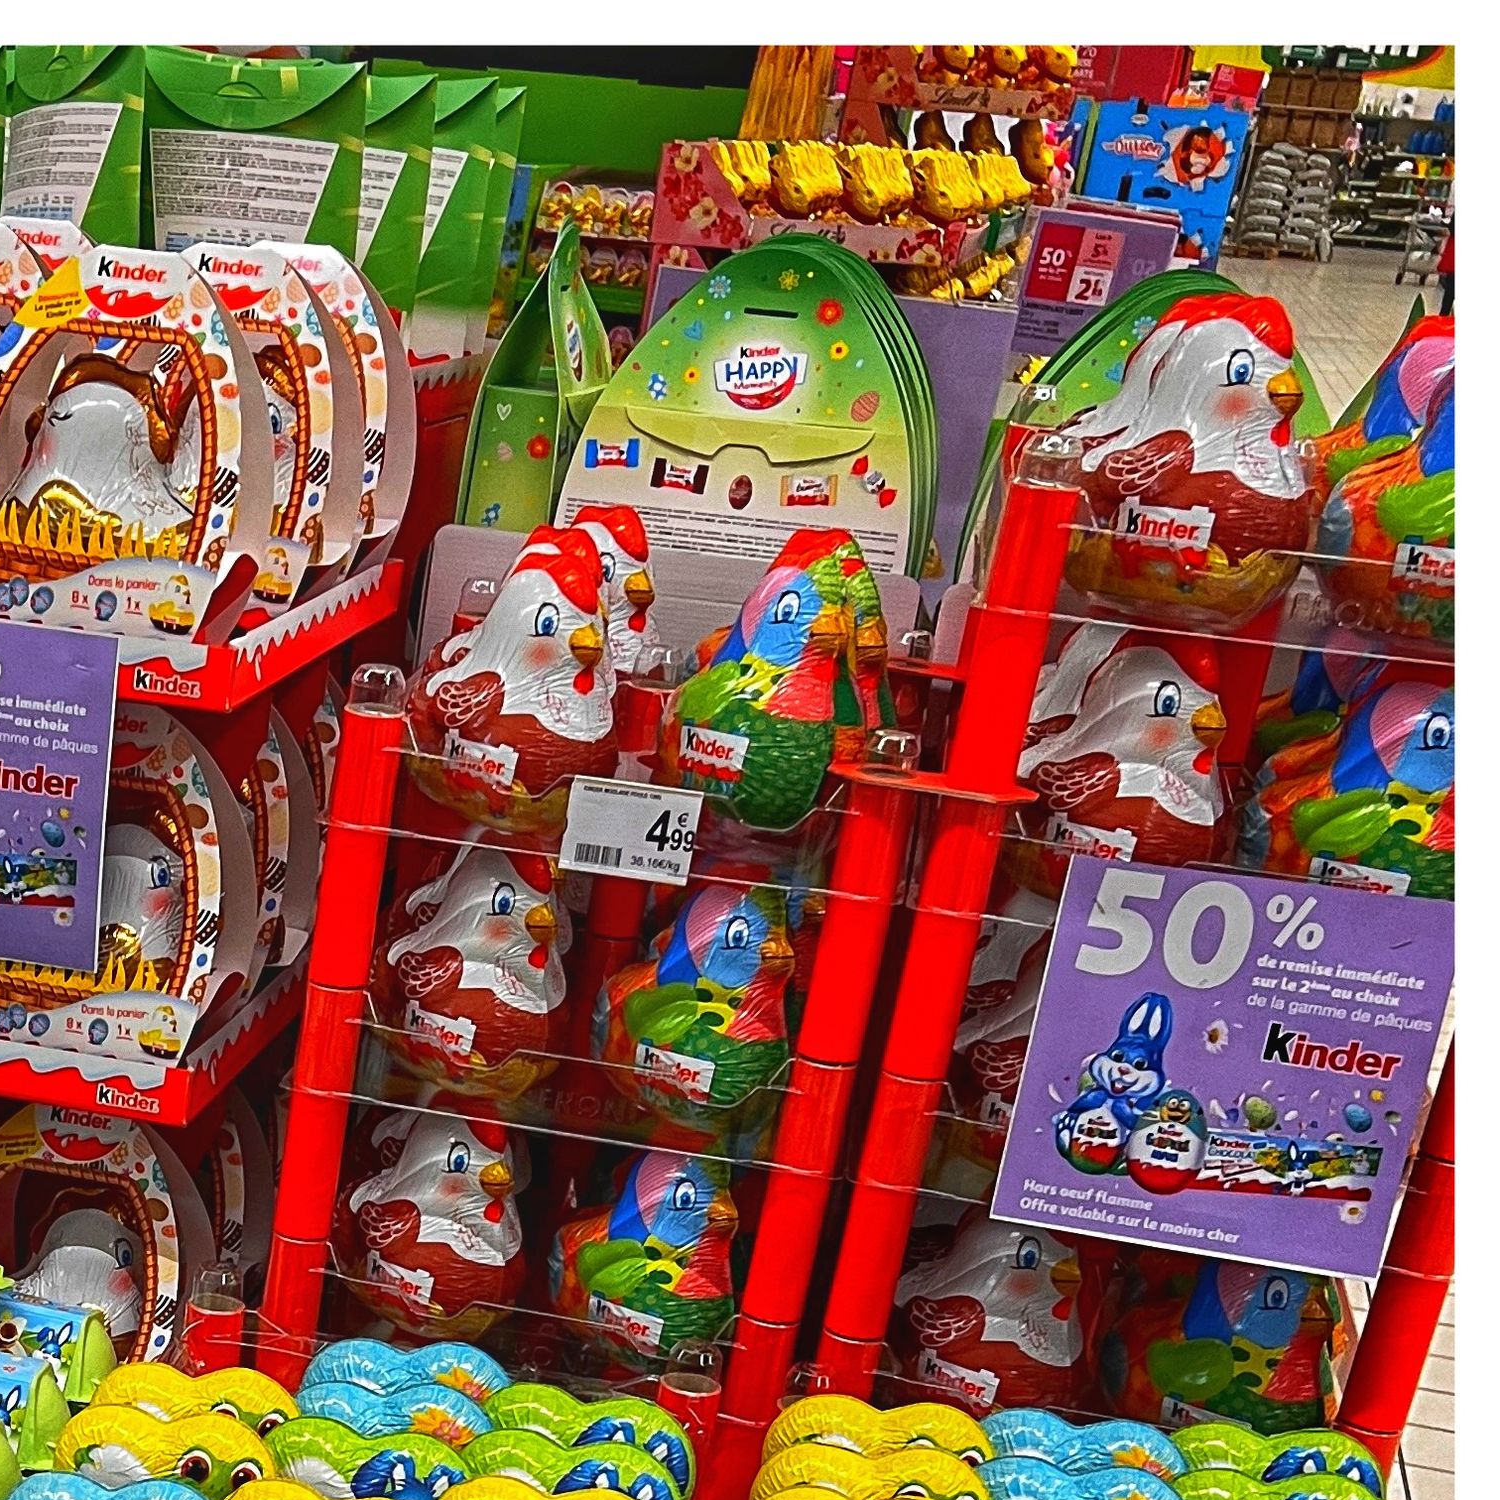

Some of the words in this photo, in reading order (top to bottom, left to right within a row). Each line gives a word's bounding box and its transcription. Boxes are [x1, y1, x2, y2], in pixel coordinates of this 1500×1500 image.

[98, 256, 168, 283] Kinder
[199, 252, 263, 277] Kinder
[740, 346, 780, 359] Kinder
[726, 356, 798, 382] HAPPY
[136, 670, 200, 696] Kinder
[15, 694, 87, 716] immédiate
[687, 729, 735, 761] Kinder
[1076, 868, 1324, 989] 50%
[1263, 1023, 1400, 1078] Kinder
[99, 1086, 159, 1112] Kinder
[1019, 1196, 1058, 1214] Offre
[1060, 1205, 1116, 1223] valable
[1116, 1215, 1142, 1227] sur
[1142, 1216, 1158, 1230] le
[1159, 1222, 1205, 1238] moins
[1206, 1227, 1240, 1244] cher
